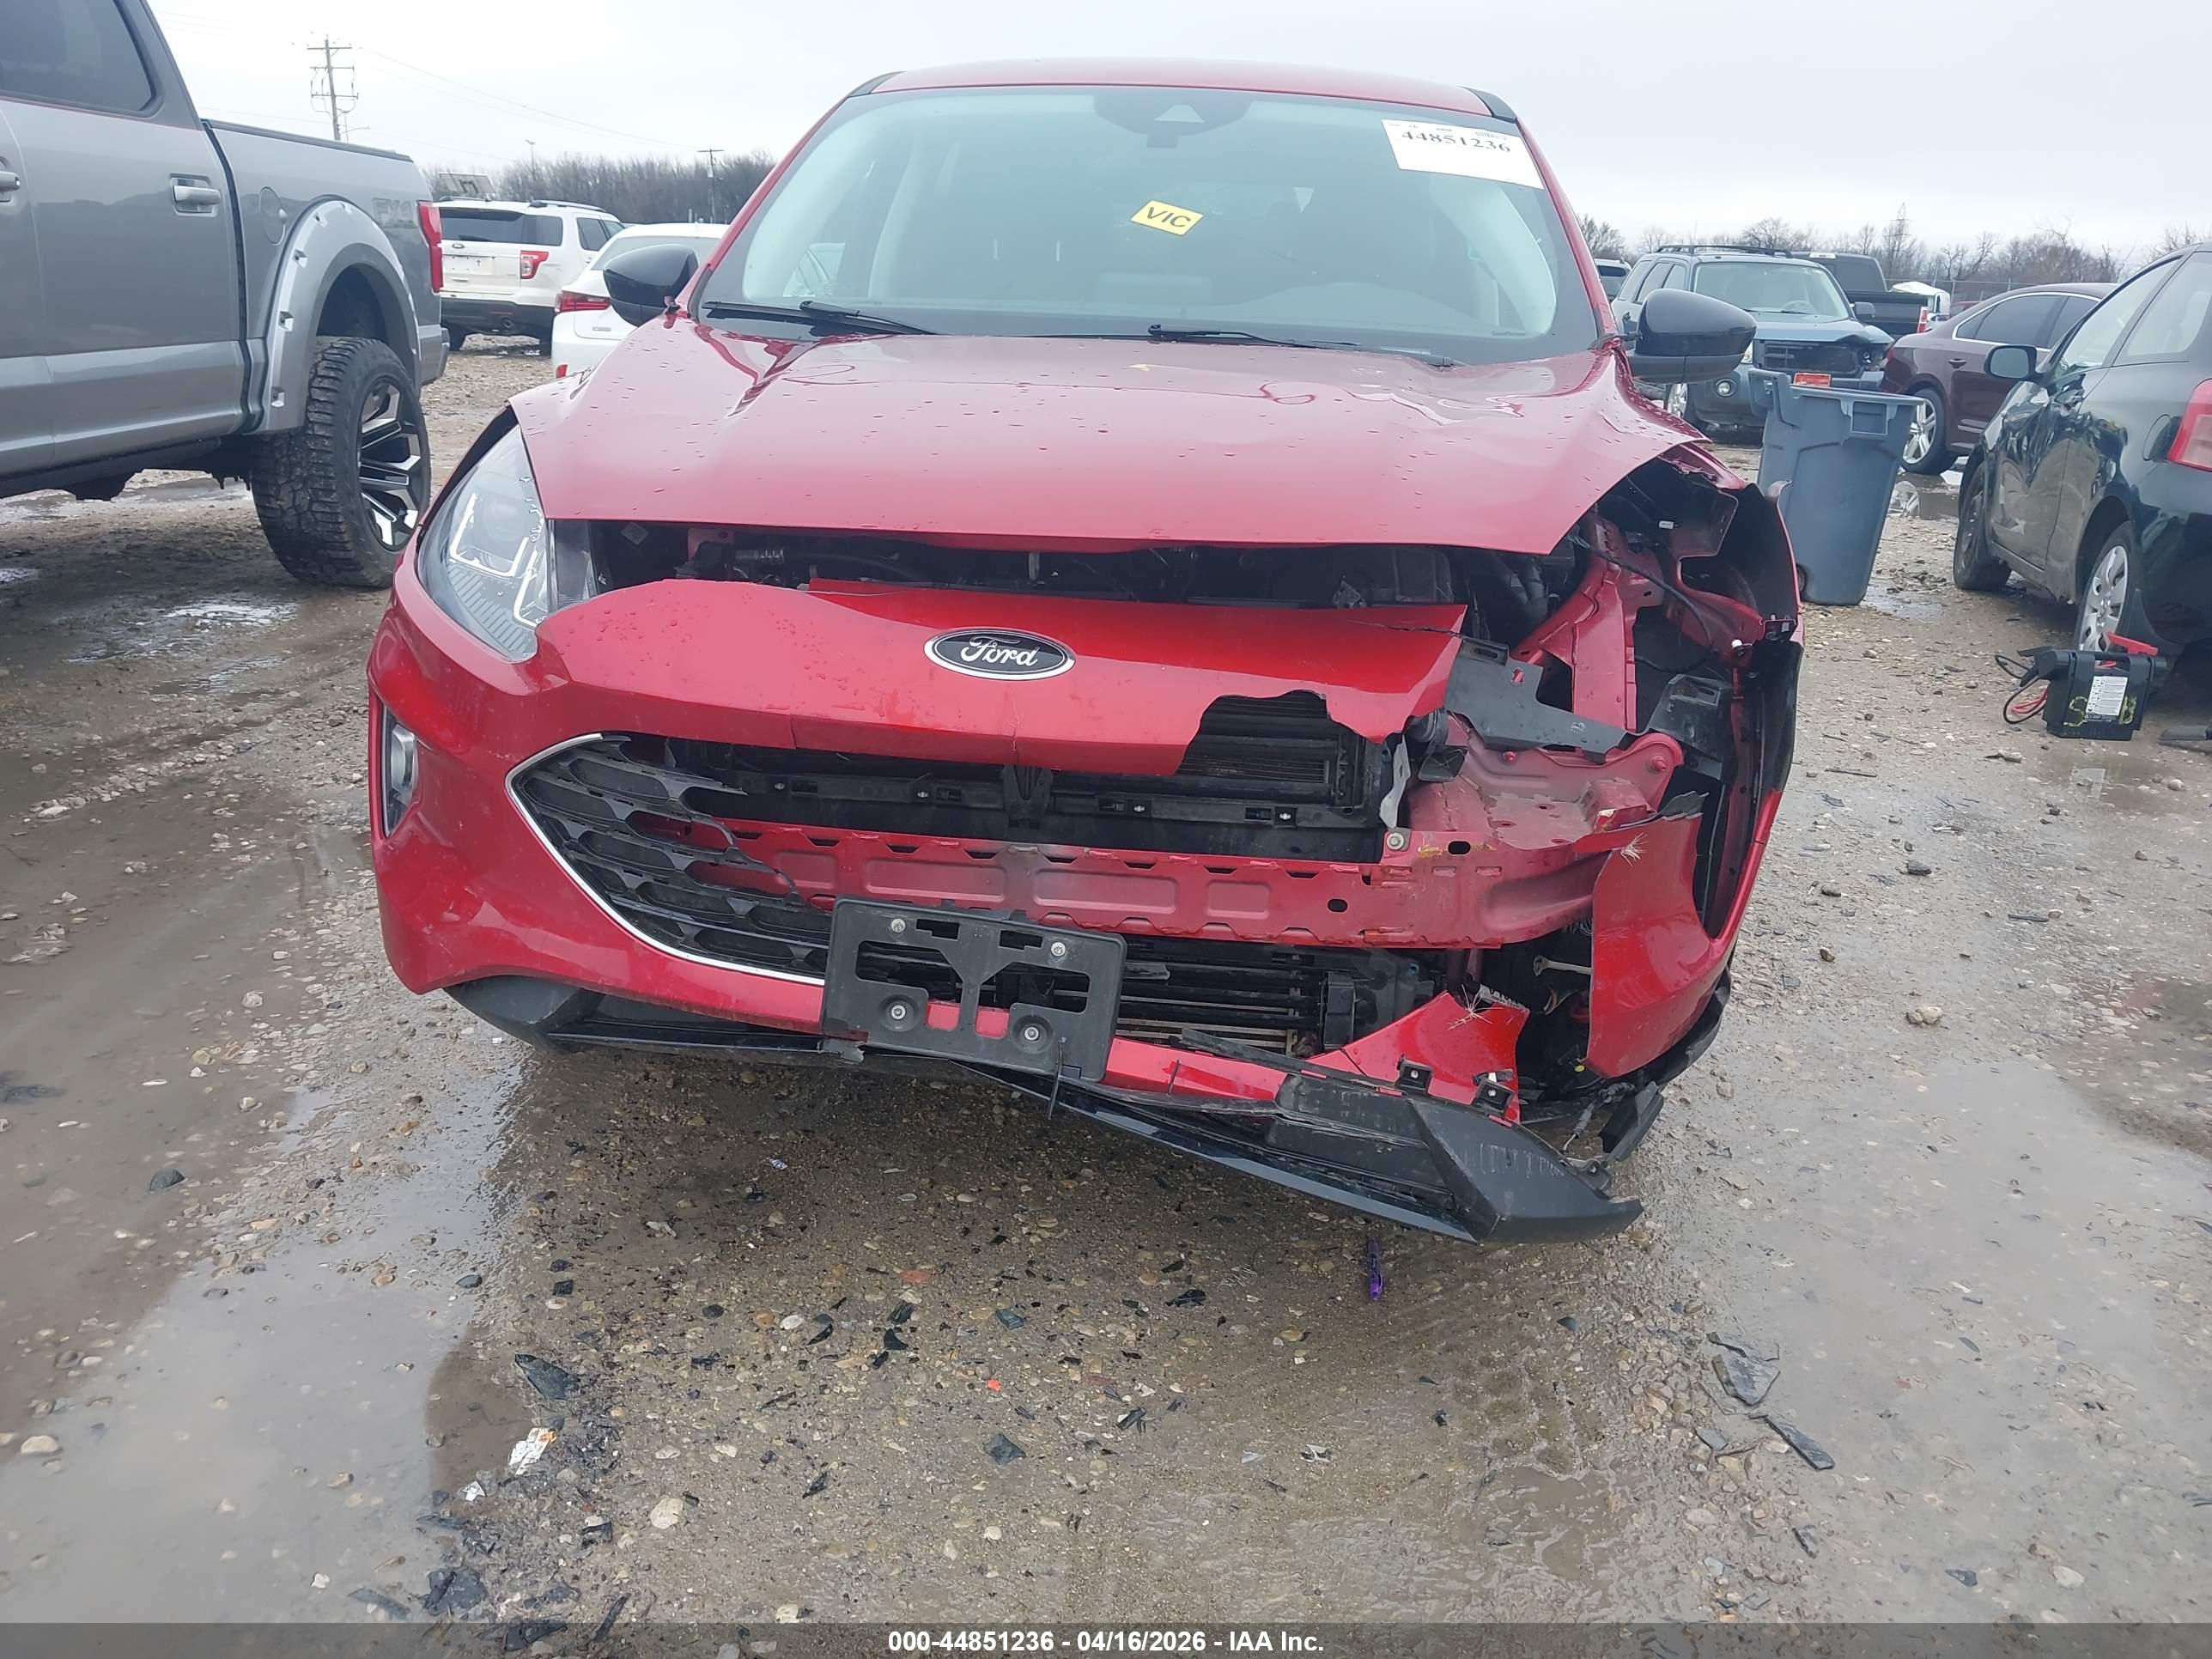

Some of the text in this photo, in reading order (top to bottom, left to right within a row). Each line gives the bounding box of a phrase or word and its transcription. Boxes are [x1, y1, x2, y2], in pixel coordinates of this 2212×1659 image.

[1401, 131, 1511, 153] 44851236
[1146, 206, 1192, 228] VIC
[960, 635, 1039, 666] Ford
